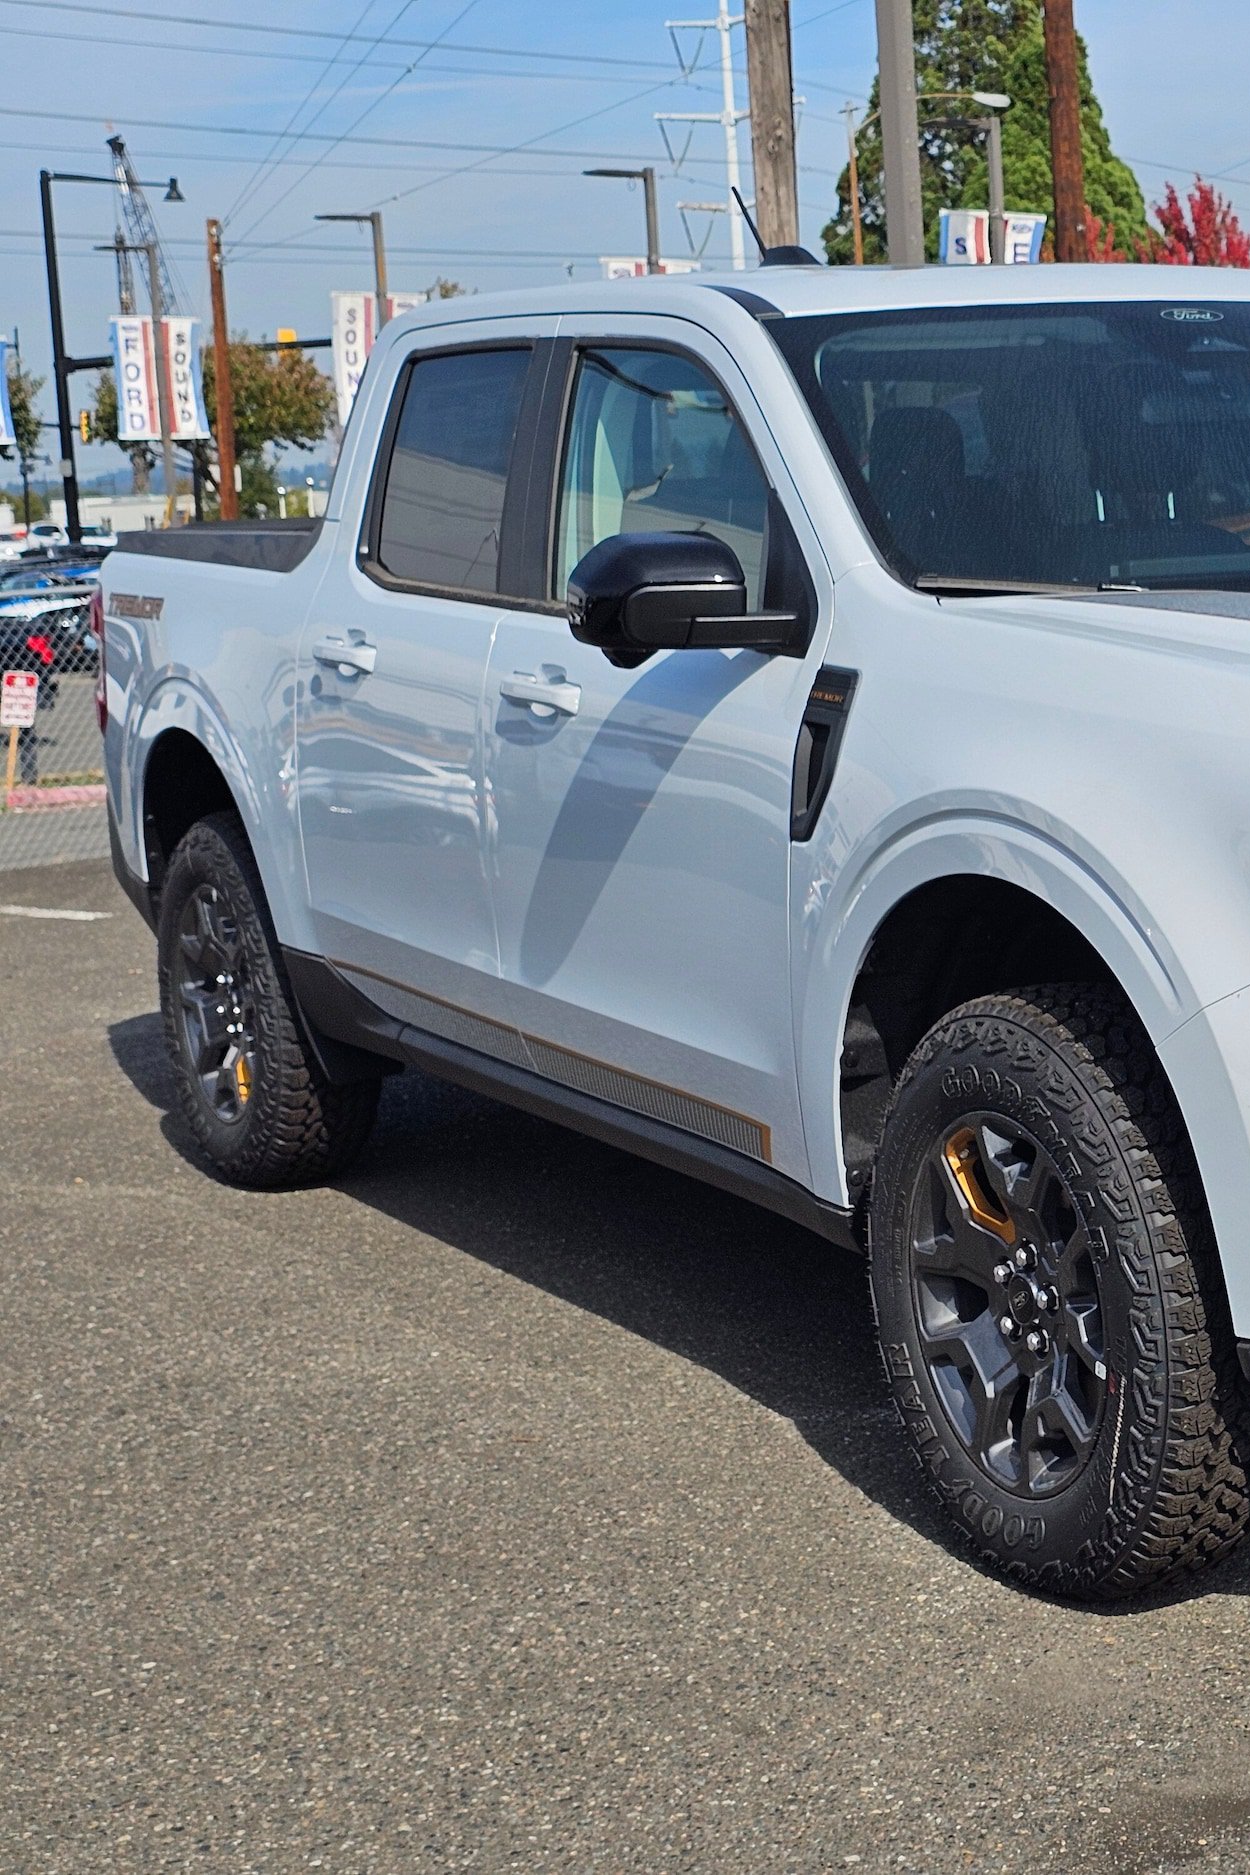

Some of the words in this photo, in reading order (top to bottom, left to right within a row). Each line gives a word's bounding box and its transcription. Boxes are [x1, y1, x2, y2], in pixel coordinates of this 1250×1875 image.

[124, 337, 146, 431] FORD
[174, 333, 192, 423] SOUND
[887, 1341, 1046, 1550] GOODYEAR
